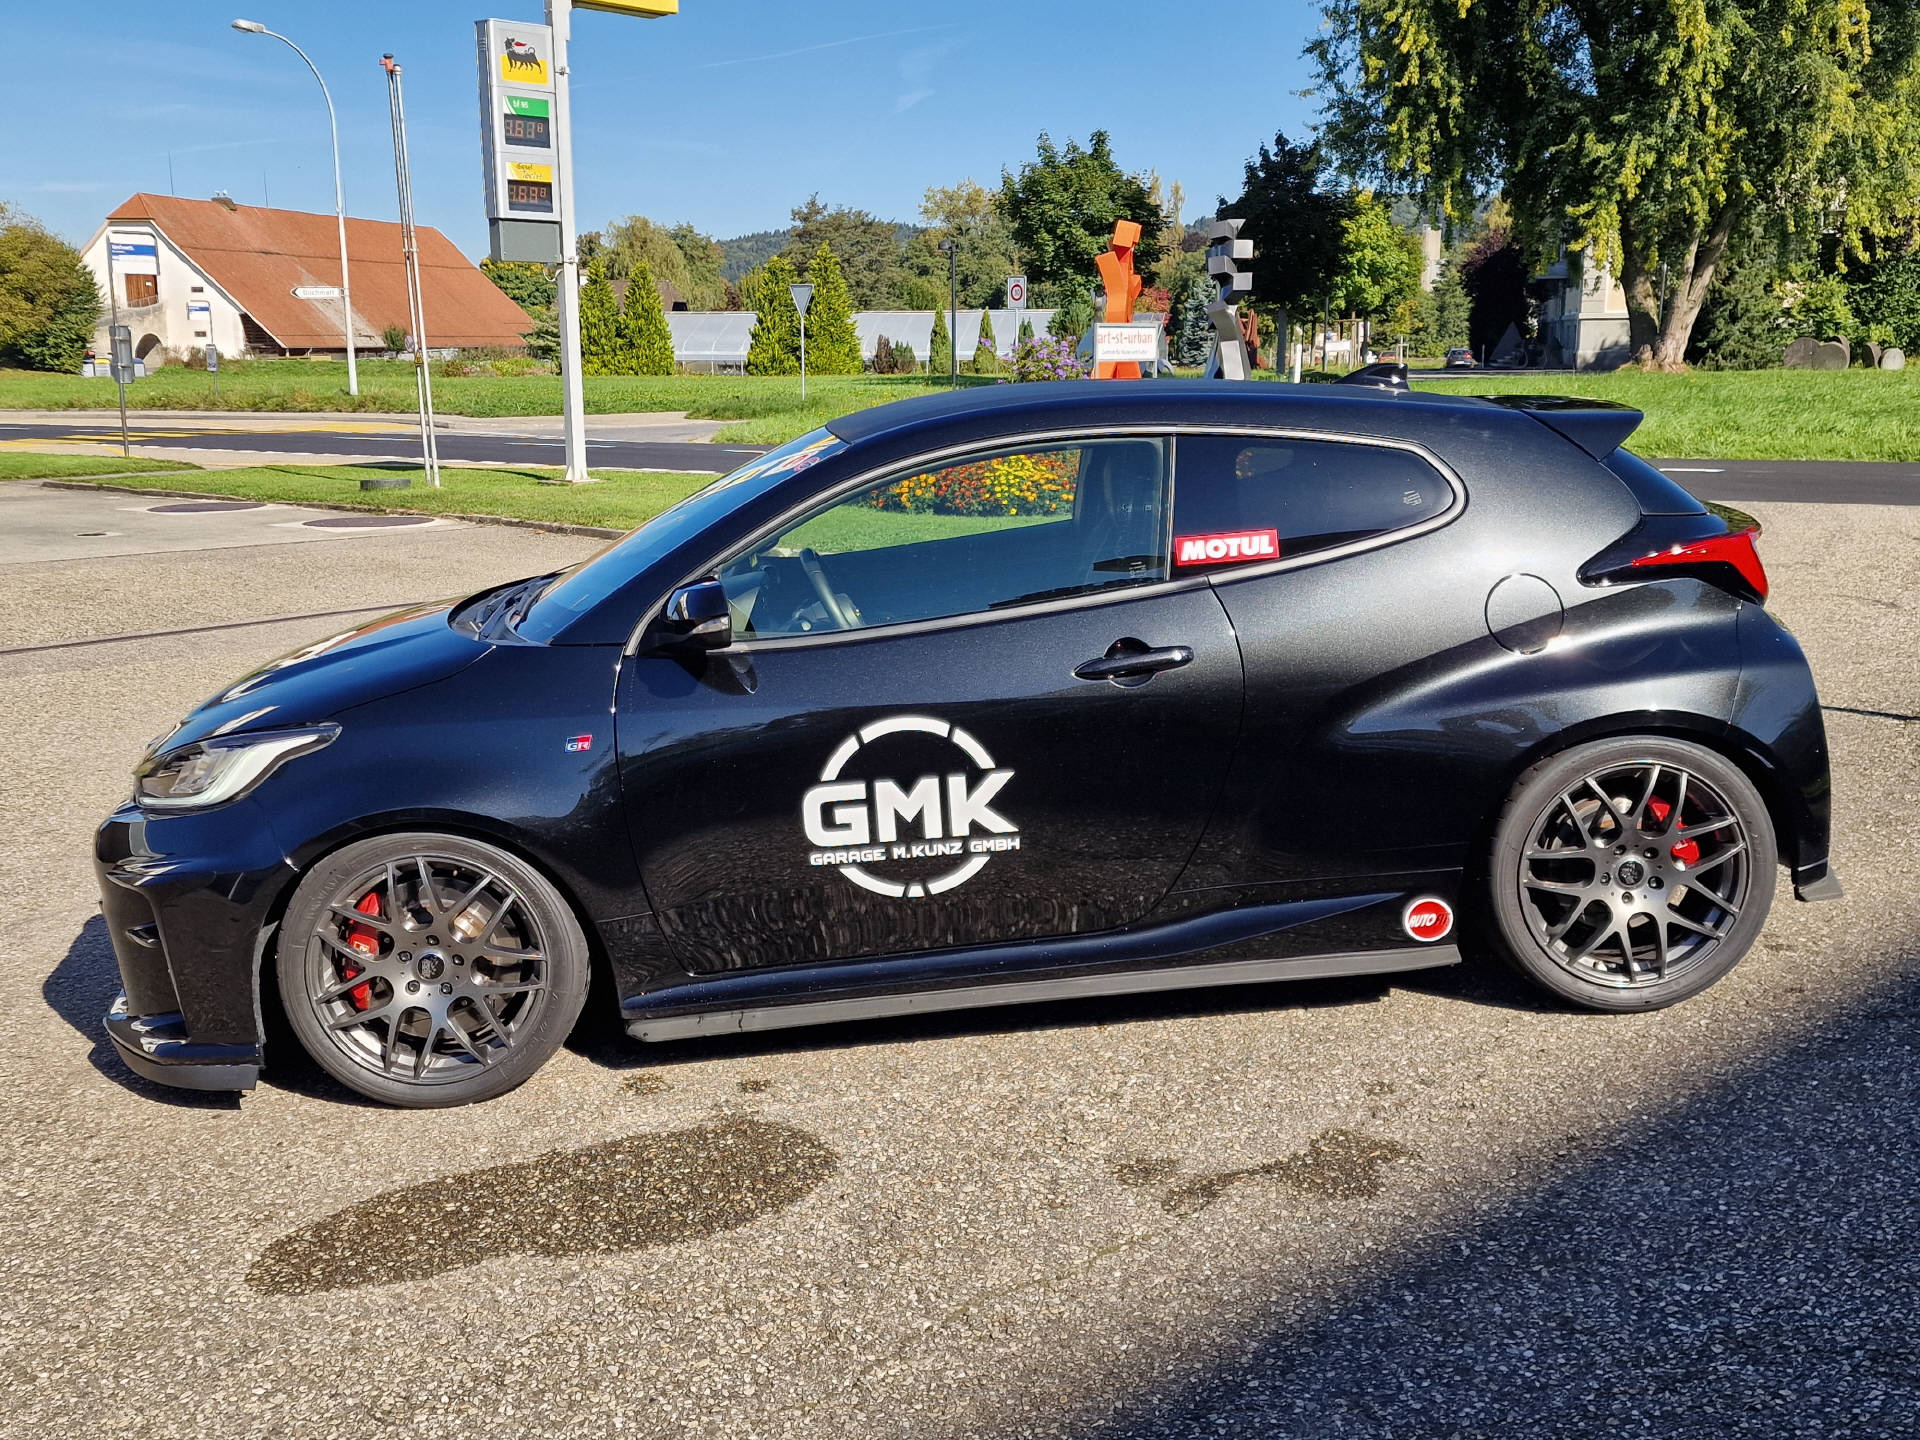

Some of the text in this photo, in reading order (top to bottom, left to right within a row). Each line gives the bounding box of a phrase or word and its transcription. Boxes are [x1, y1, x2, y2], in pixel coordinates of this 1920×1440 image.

[1181, 535, 1274, 562] MOTUL
[803, 771, 1019, 847] GMK
[810, 837, 1021, 866] GARAGE M.KUNZ GMBH
